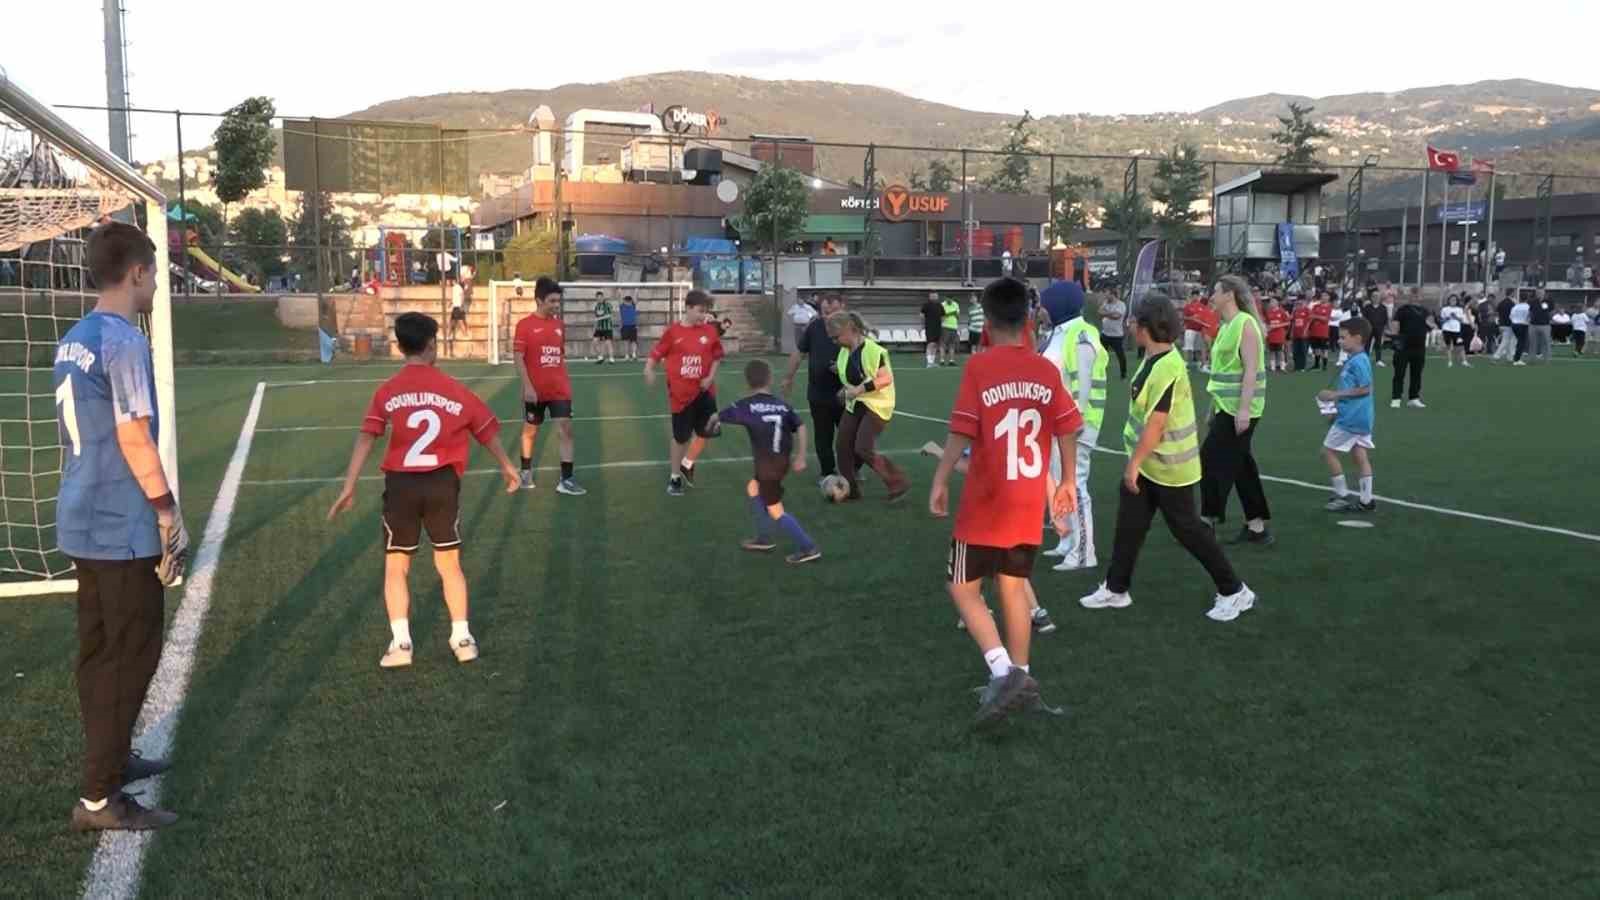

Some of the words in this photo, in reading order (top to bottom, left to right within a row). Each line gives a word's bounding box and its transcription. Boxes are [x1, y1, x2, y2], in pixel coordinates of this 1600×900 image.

[56, 373, 81, 456] 1
[384, 391, 463, 416] ODUNLUKSPOR
[402, 409, 442, 467] 2
[761, 414, 782, 453] 7
[994, 407, 1043, 480] 13
